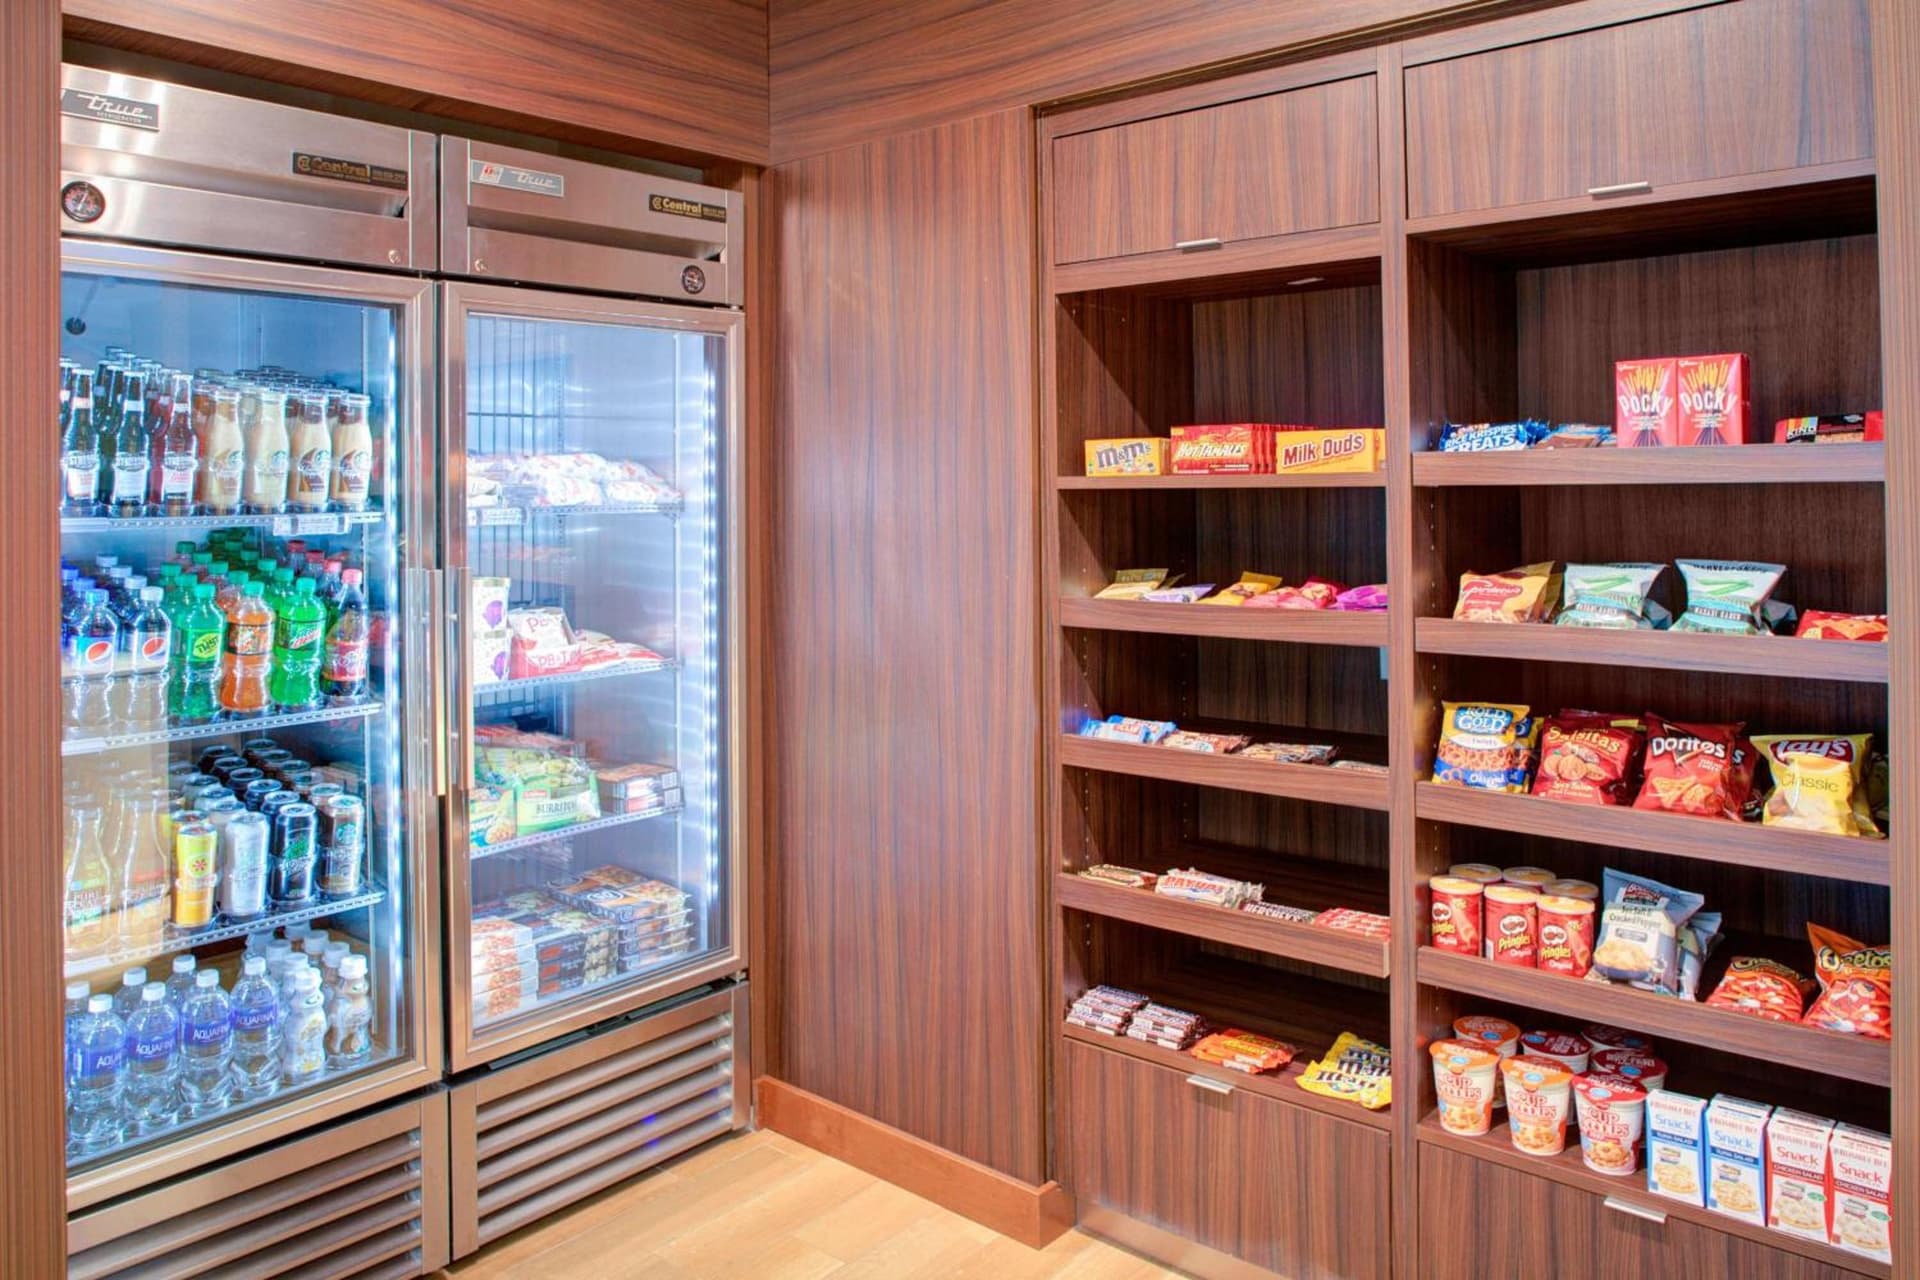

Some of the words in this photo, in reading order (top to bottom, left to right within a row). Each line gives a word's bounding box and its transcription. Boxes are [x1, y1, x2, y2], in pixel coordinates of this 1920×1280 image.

[662, 198, 702, 213] Central
[1283, 442, 1316, 465] Milk
[1323, 434, 1362, 456] Duds
[1458, 716, 1505, 732] GOLD
[1652, 737, 1726, 759] Doritos
[1780, 773, 1840, 793] Classic
[193, 1025, 229, 1041] AQUAFIN
[136, 1041, 173, 1056] AQUAFIN
[1655, 1113, 1693, 1132] Snack
[1714, 1130, 1754, 1149] Snack
[1776, 1146, 1819, 1165] Snack
[1839, 1162, 1883, 1184] Snack
